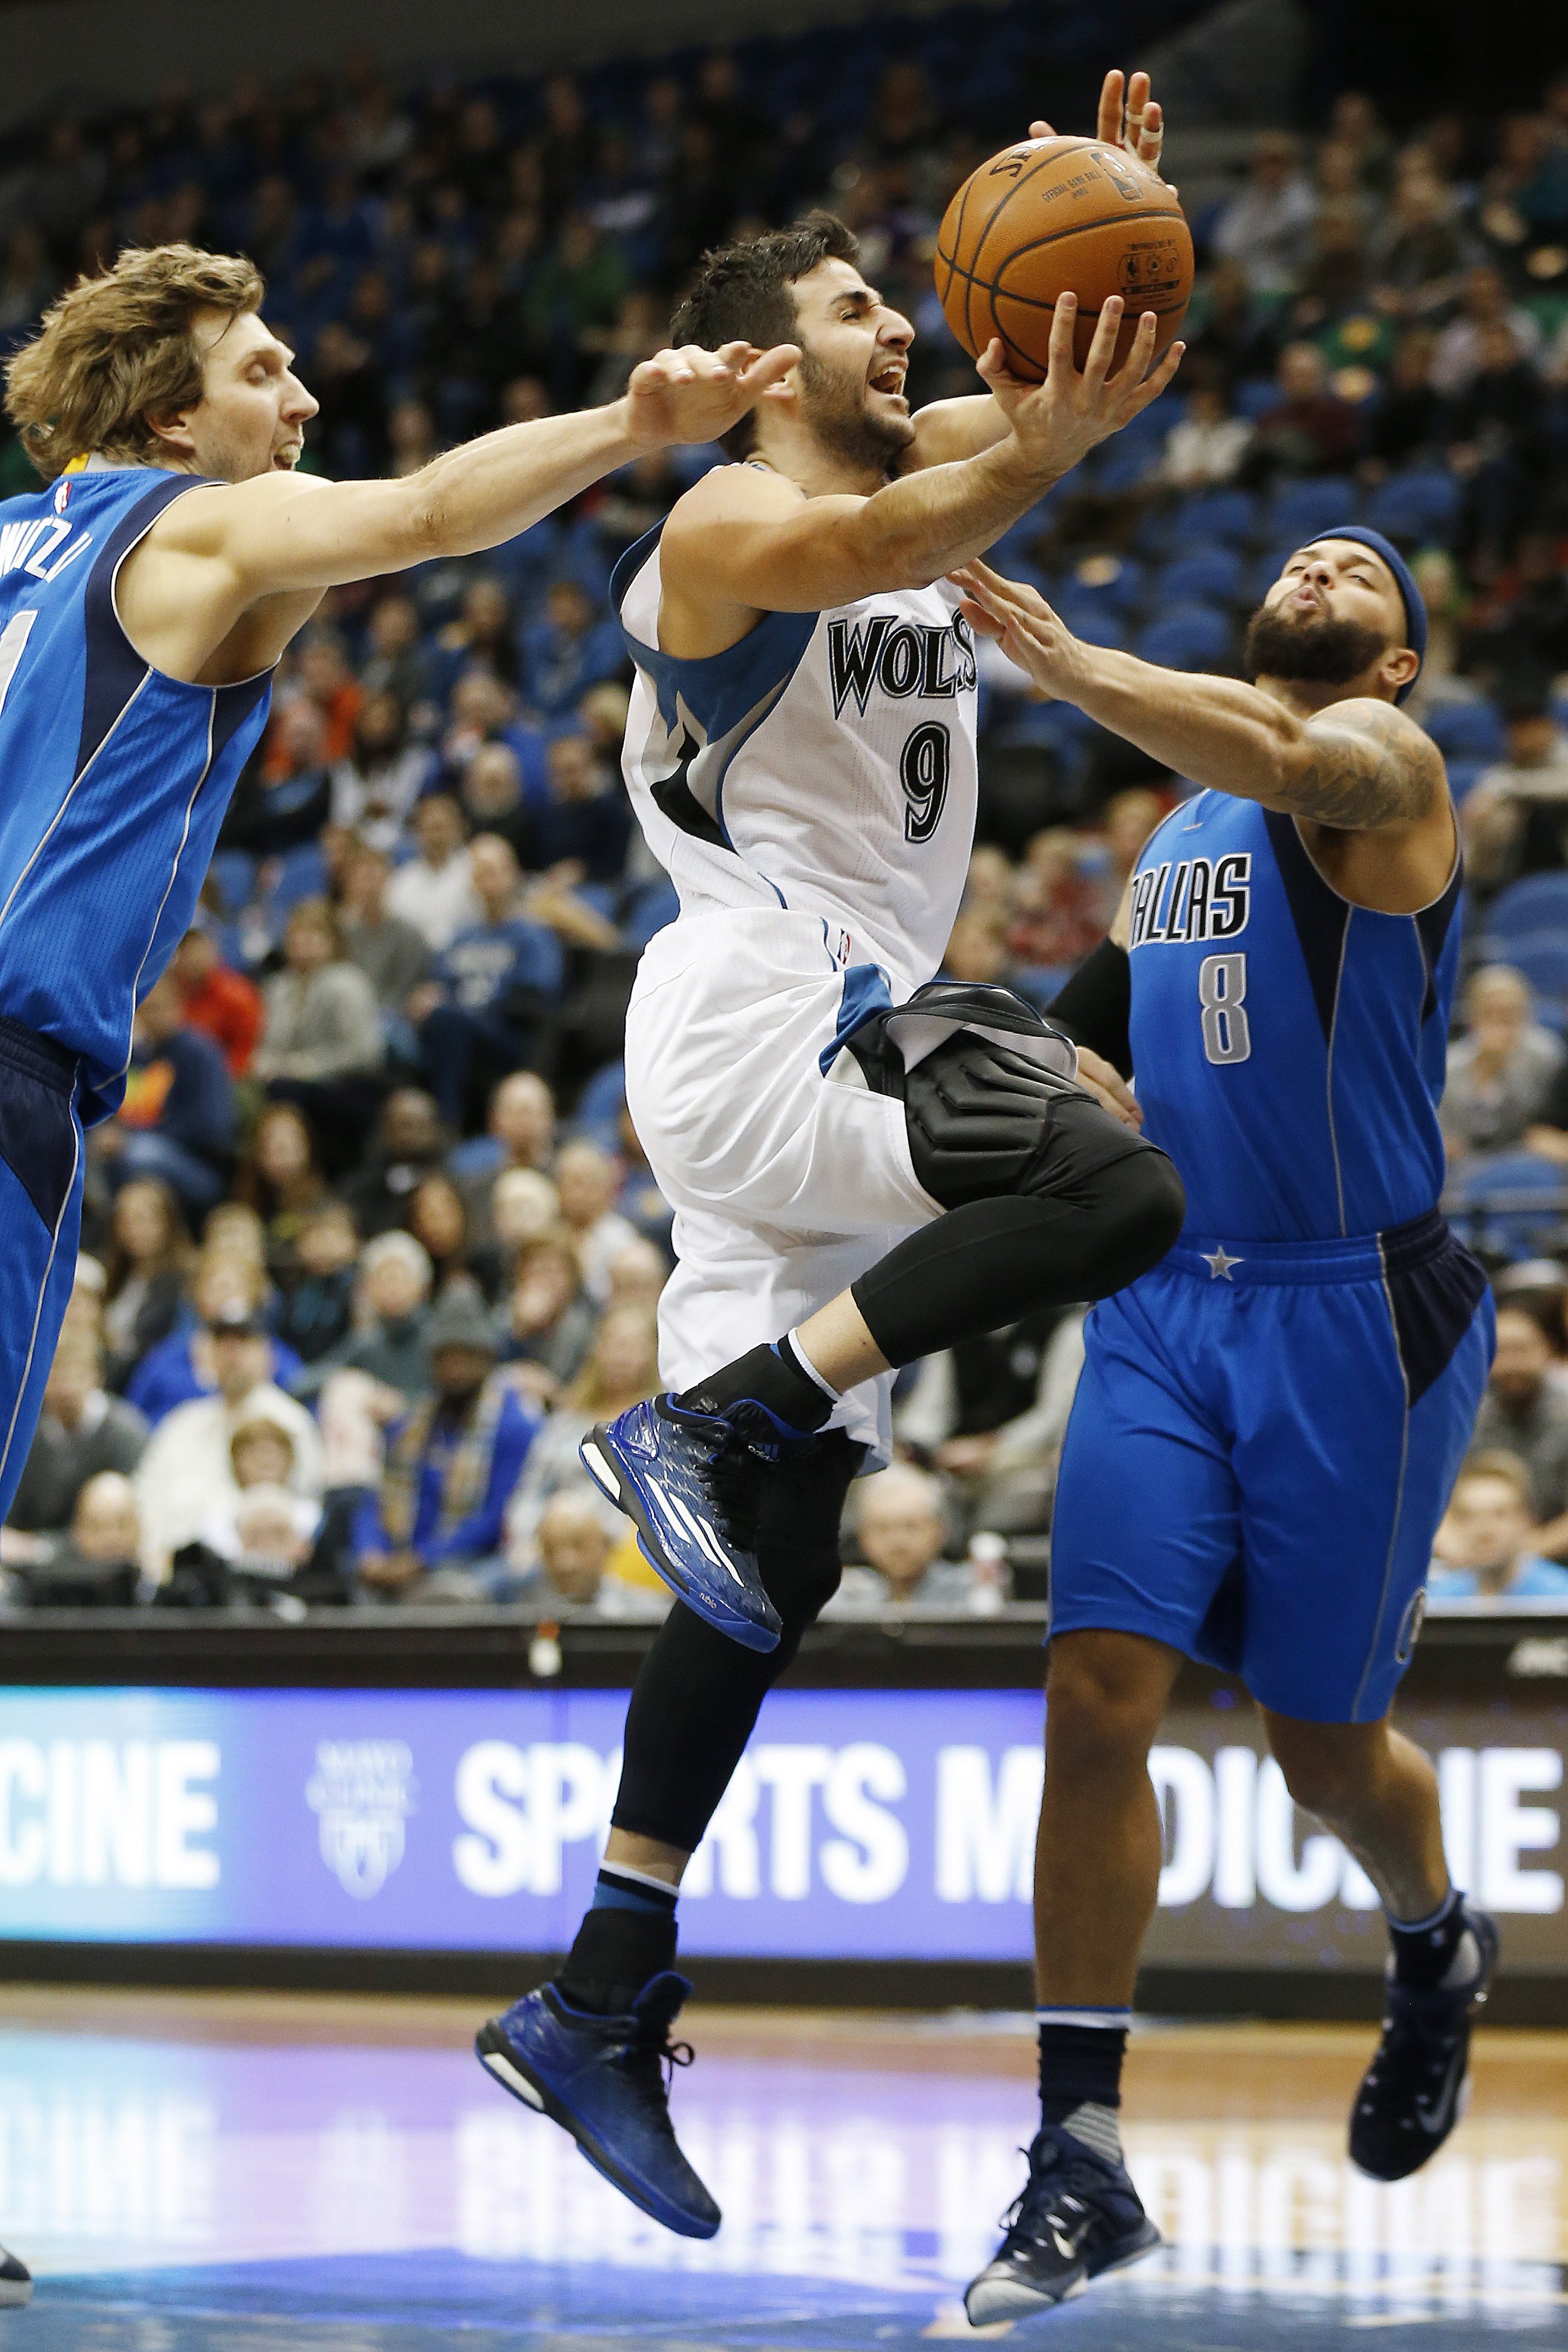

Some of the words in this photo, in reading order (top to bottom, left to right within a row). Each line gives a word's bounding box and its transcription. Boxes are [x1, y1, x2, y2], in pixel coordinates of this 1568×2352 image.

[828, 607, 977, 720] WOLS
[900, 720, 950, 844] 9
[1129, 852, 1253, 953] ALLAS
[1198, 952, 1252, 1065] 8
[452, 1739, 910, 1904] SPRTS
[935, 1743, 1565, 1914] MDICE
